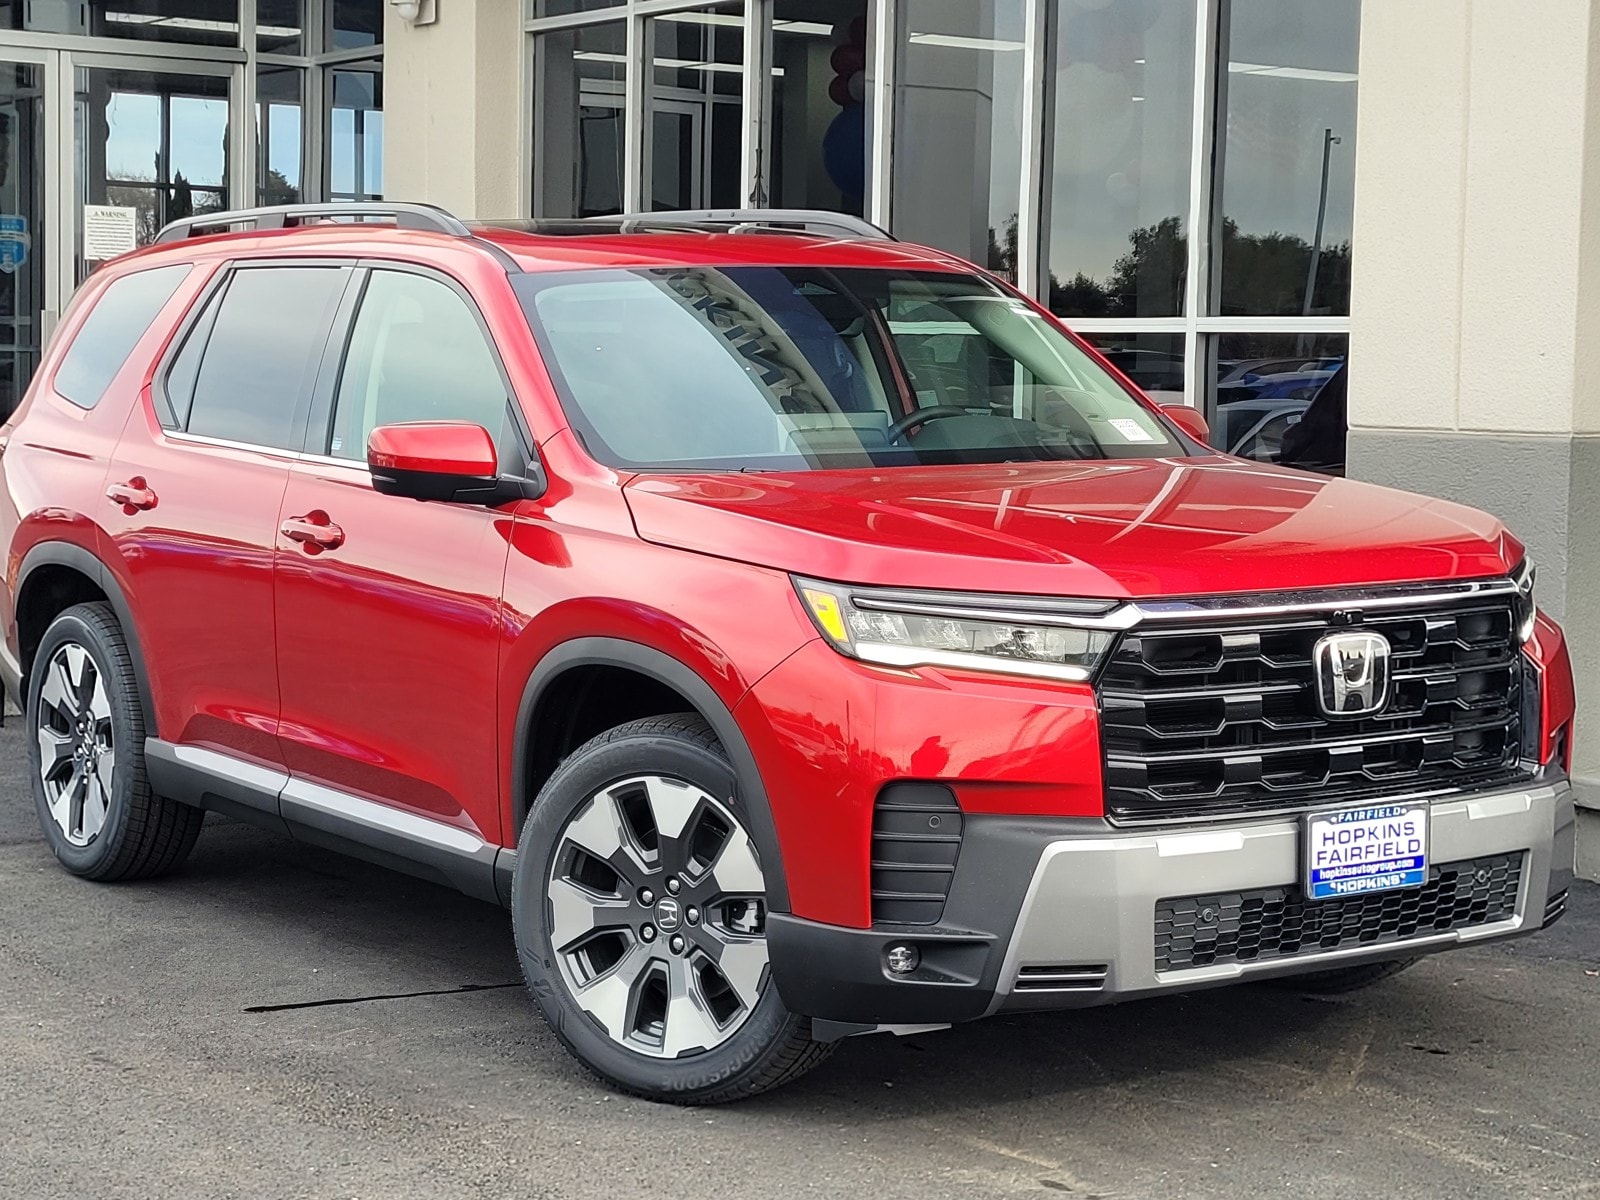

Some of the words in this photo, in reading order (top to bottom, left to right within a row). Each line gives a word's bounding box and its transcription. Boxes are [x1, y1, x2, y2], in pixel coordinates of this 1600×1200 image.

[1338, 807, 1401, 822] FAIRFIELD
[1323, 822, 1415, 847] HOPKINS
[1317, 839, 1420, 866] FAIRFIELD
[1319, 859, 1415, 880] hopkinsautogroup.com
[1336, 874, 1400, 893] HOPKINS
